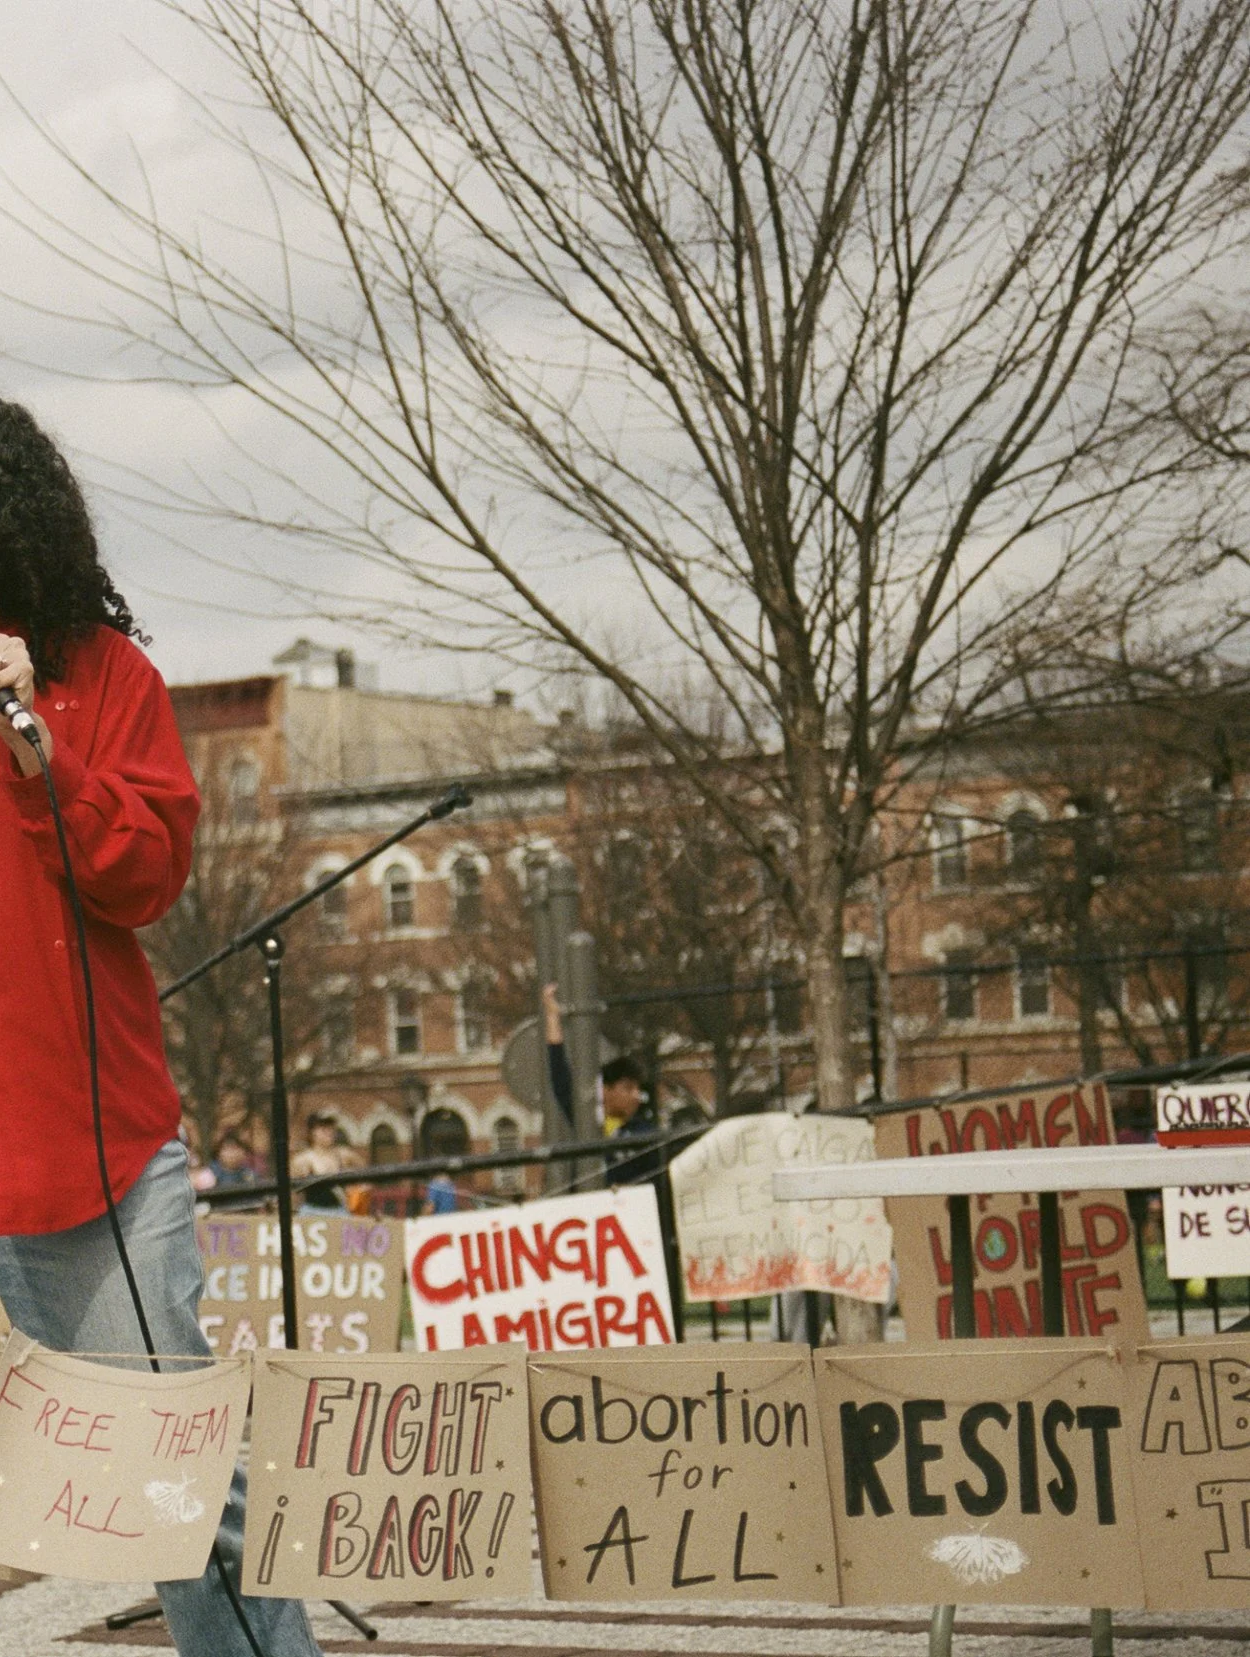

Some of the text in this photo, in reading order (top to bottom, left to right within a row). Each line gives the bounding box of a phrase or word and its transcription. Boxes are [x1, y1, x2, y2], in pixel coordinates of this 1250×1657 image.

[906, 1084, 1110, 1157] WOMEN
[1162, 1093, 1250, 1123] QUIER
[341, 1223, 392, 1257] NO
[1179, 1211, 1212, 1238] DE
[301, 1261, 387, 1301] OUR
[152, 1402, 230, 1461] THEM
[295, 1376, 504, 1476] FIGHT
[540, 1371, 809, 1448] abortion
[648, 1449, 734, 1498] for
[839, 1398, 1122, 1525] RESIST
[44, 1480, 144, 1538] ALL
[584, 1505, 779, 1589] ALL
